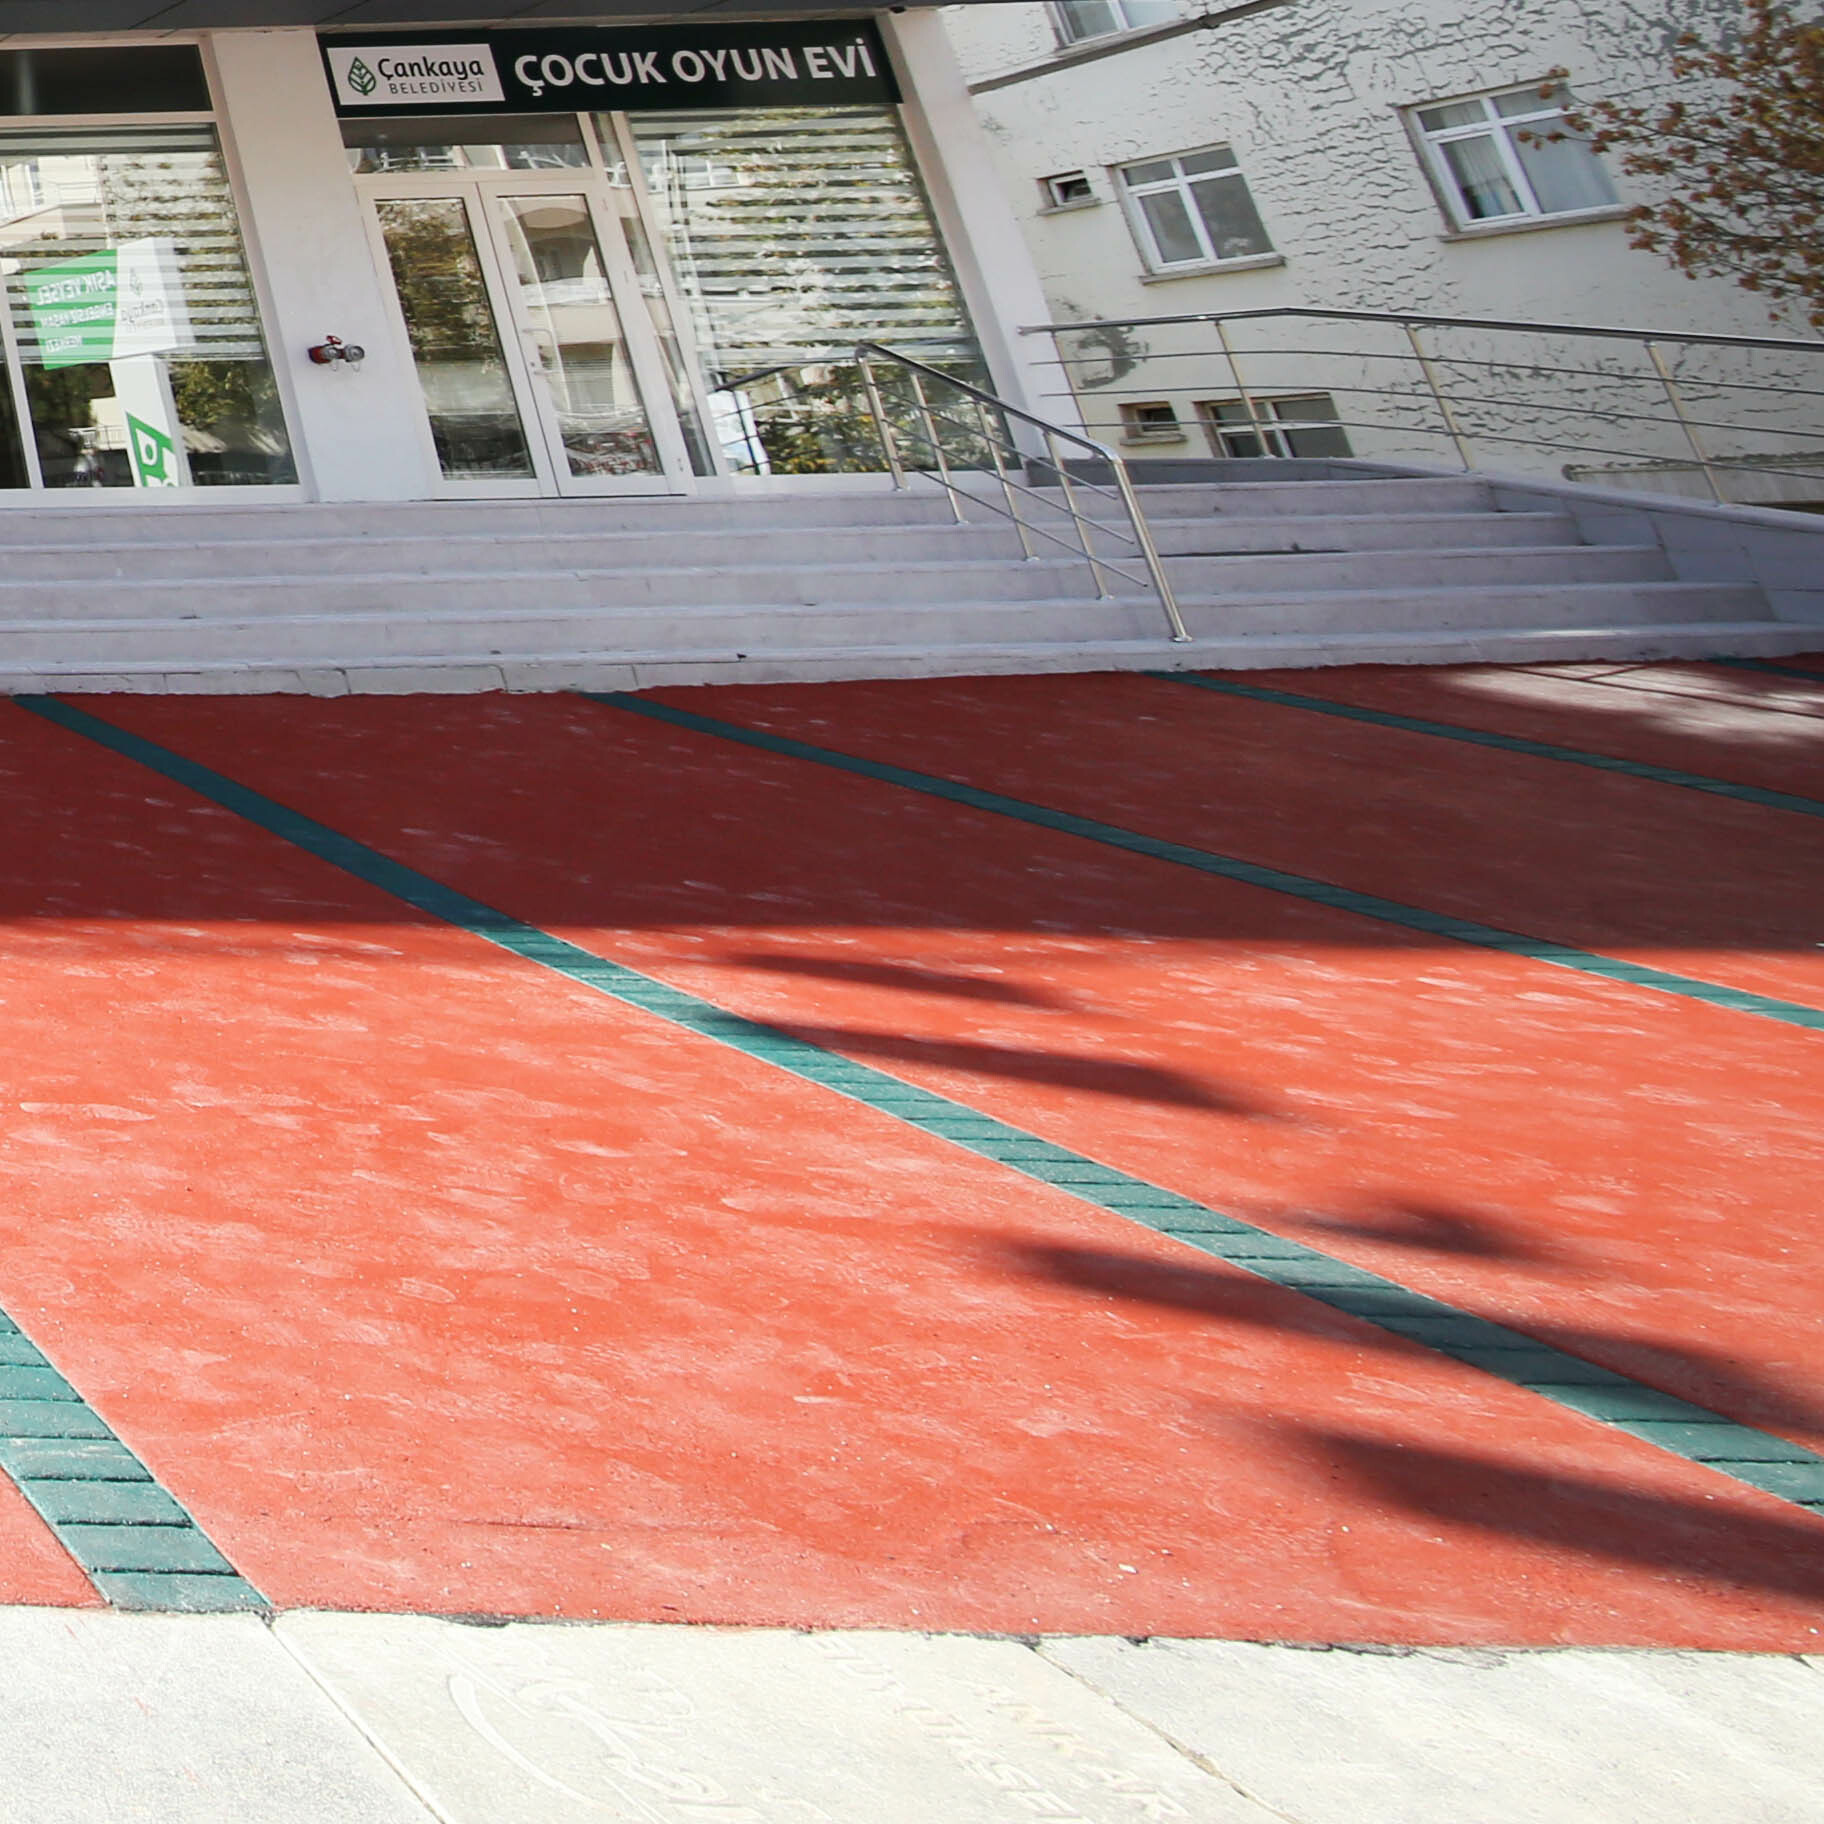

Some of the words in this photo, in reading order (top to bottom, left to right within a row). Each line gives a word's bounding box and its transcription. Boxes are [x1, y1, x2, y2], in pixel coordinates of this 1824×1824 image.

[377, 55, 485, 83] Çankaya
[513, 49, 667, 97] ÇOCUK
[672, 46, 799, 84] OYUN
[804, 36, 877, 81] EVİ
[387, 76, 485, 96] BELEDİYESİ
